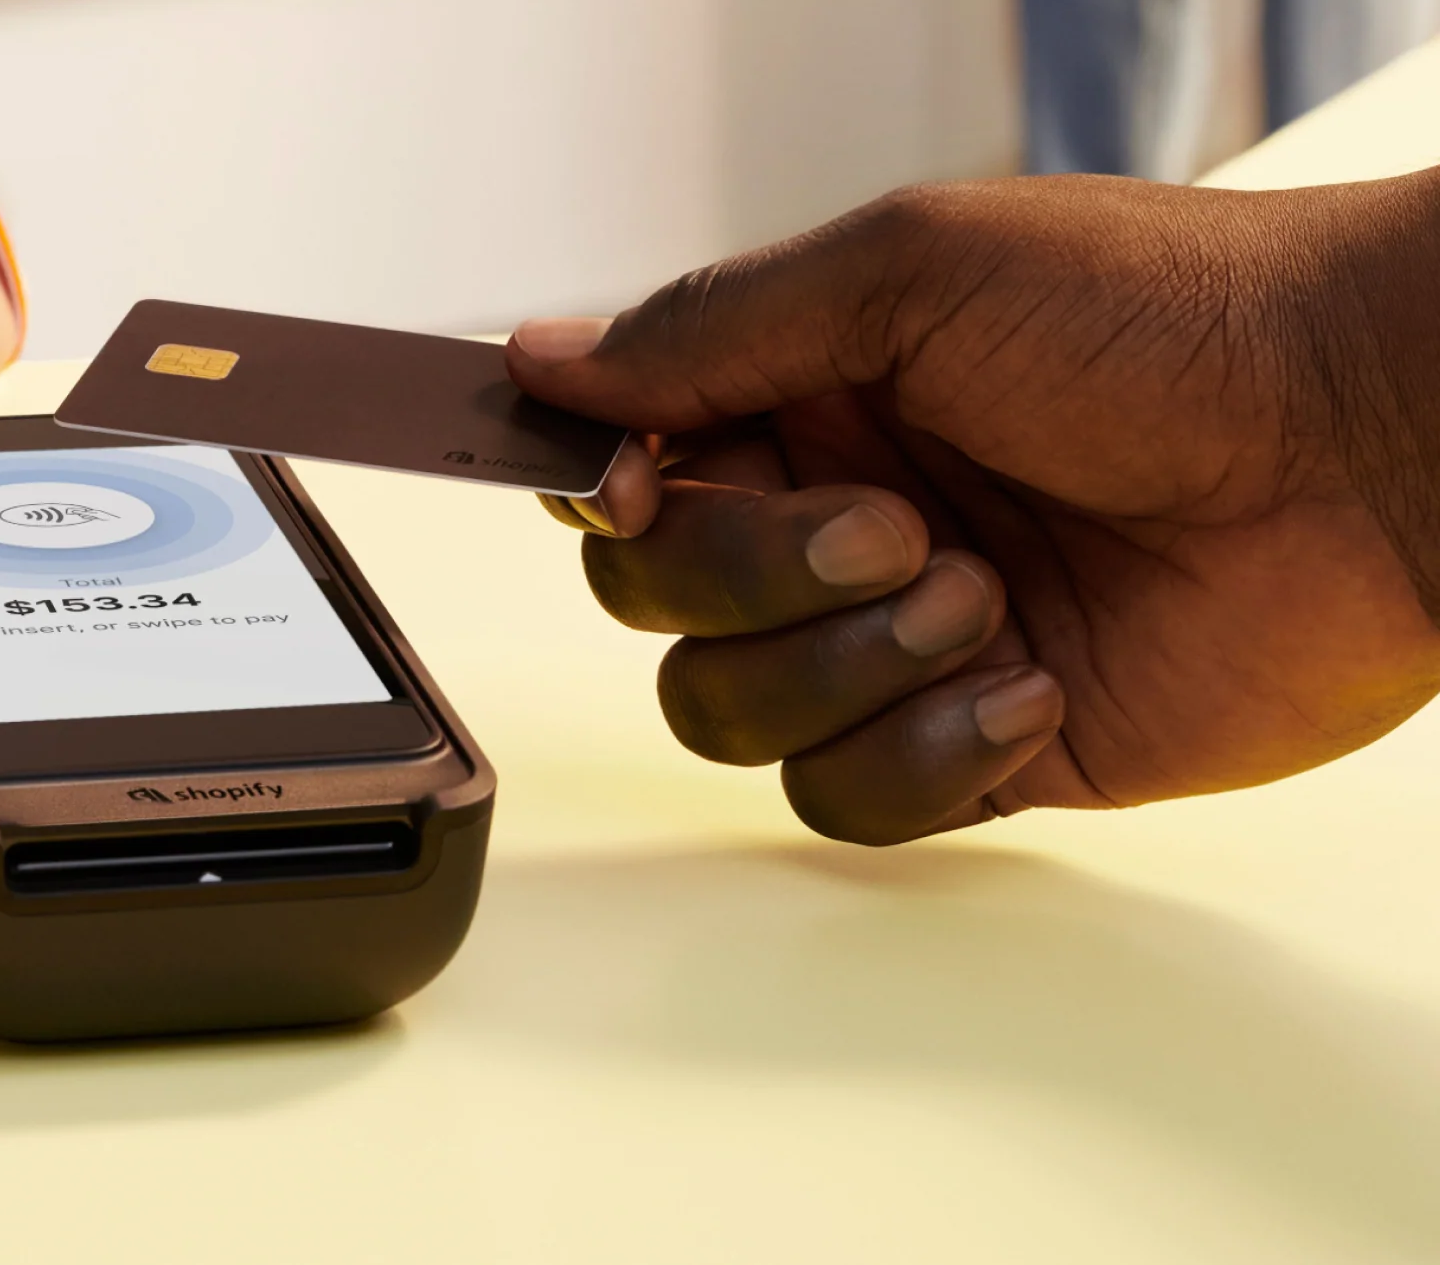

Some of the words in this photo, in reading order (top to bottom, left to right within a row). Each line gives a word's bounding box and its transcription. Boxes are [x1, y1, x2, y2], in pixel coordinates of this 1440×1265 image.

[58, 576, 122, 587] Total
[3, 592, 202, 616] $153.34
[0, 624, 84, 636] insert,
[92, 622, 118, 631] or
[127, 618, 203, 630] swipe
[209, 615, 236, 625] to
[244, 614, 289, 625] pay
[174, 782, 283, 801] shopify
